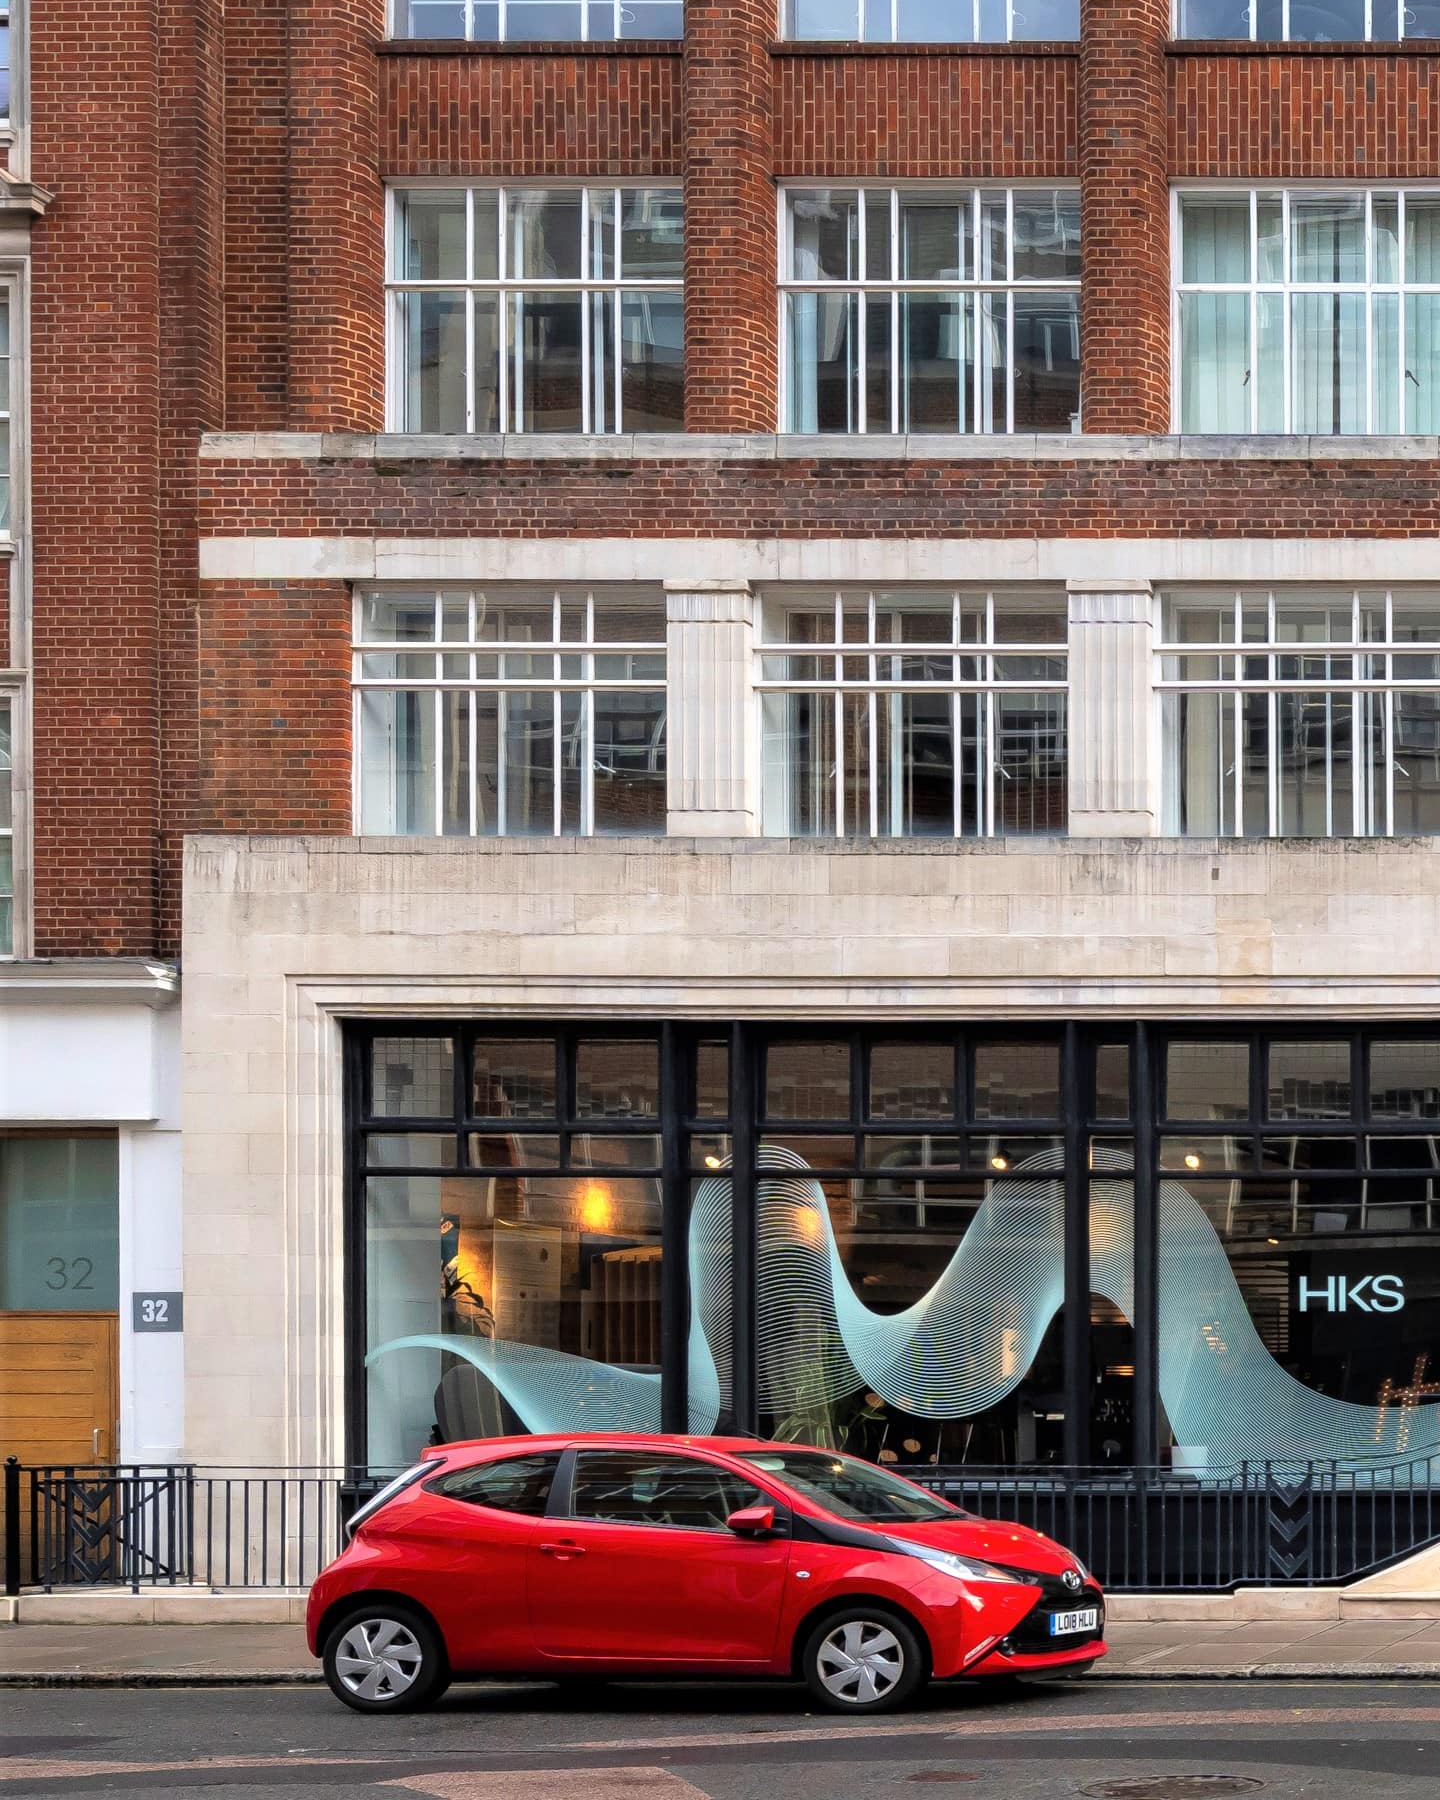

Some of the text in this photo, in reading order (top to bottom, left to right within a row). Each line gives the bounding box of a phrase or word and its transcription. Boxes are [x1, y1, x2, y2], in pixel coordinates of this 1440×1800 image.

[45, 1256, 95, 1290] 32
[1299, 1275, 1405, 1312] HKS
[142, 1299, 169, 1323] 32
[1078, 1610, 1094, 1627] HLU
